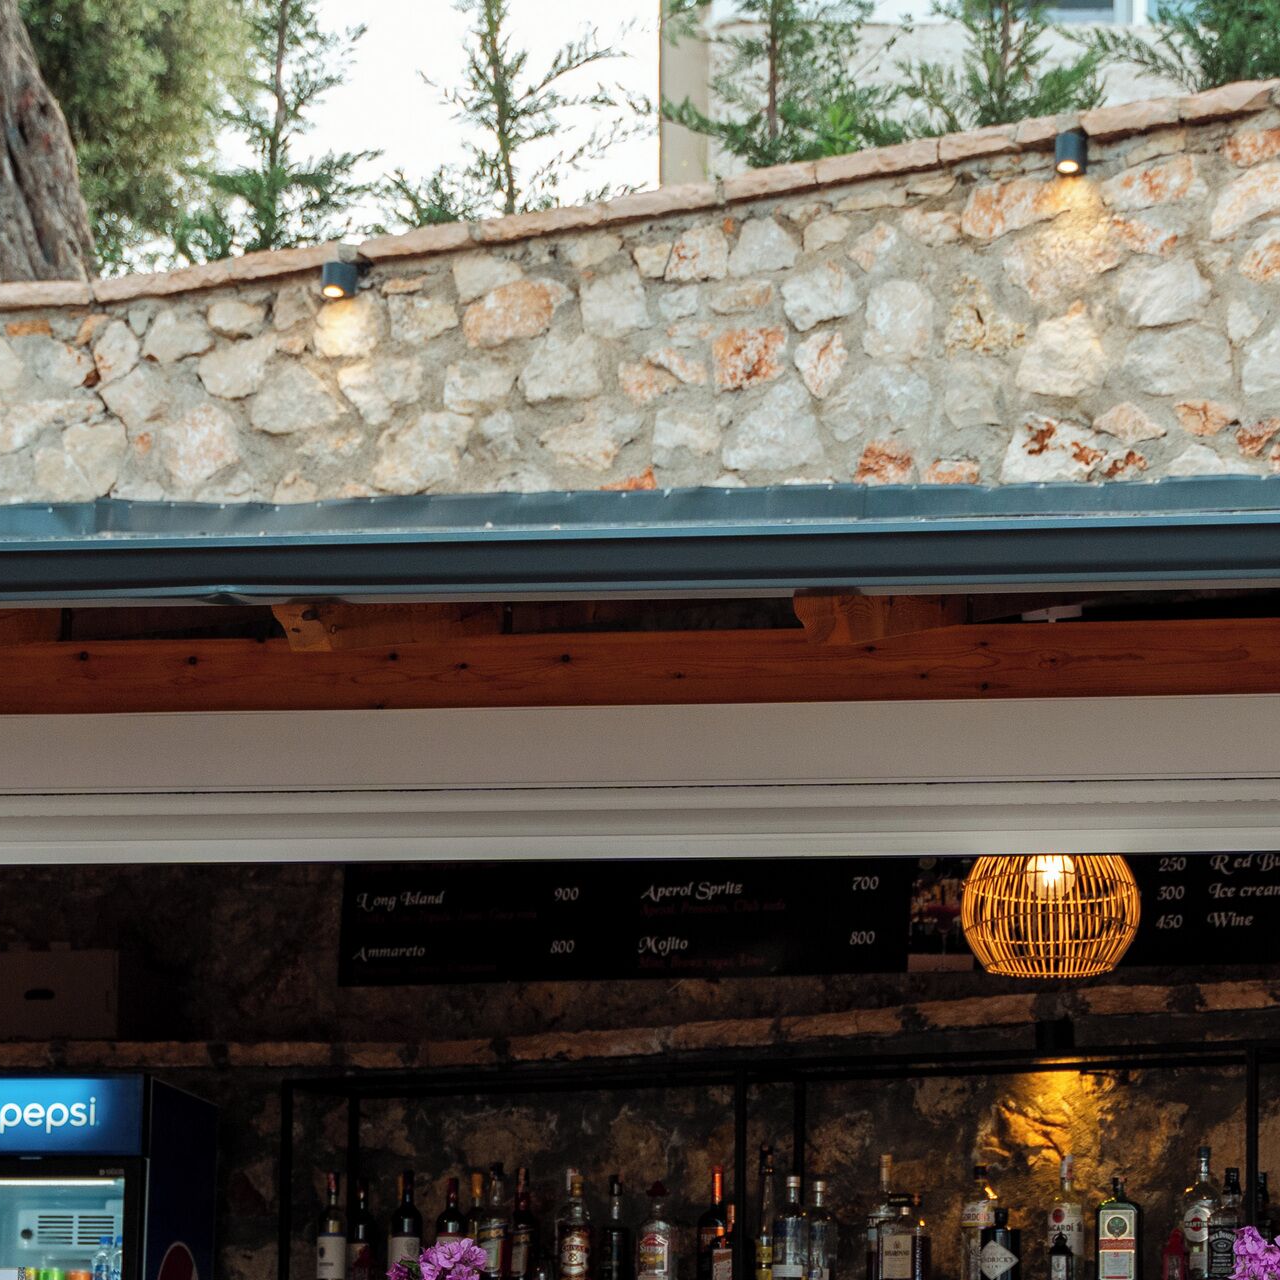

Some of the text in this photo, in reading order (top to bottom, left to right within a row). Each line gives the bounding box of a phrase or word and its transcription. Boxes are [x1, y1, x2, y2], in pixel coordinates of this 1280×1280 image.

[1158, 856, 1187, 872] 250
[640, 881, 743, 903] Aperol Spritz
[852, 876, 880, 892] 700
[1208, 885, 1236, 899] Ice
[356, 890, 446, 912] Long Island
[553, 887, 580, 903] 900
[1157, 885, 1186, 901] 300
[1156, 914, 1183, 930] 450
[1207, 911, 1254, 928] Wine
[638, 935, 689, 957] Mojito
[849, 930, 876, 946] 800
[352, 943, 427, 962] Ammareto
[549, 939, 576, 955] 800
